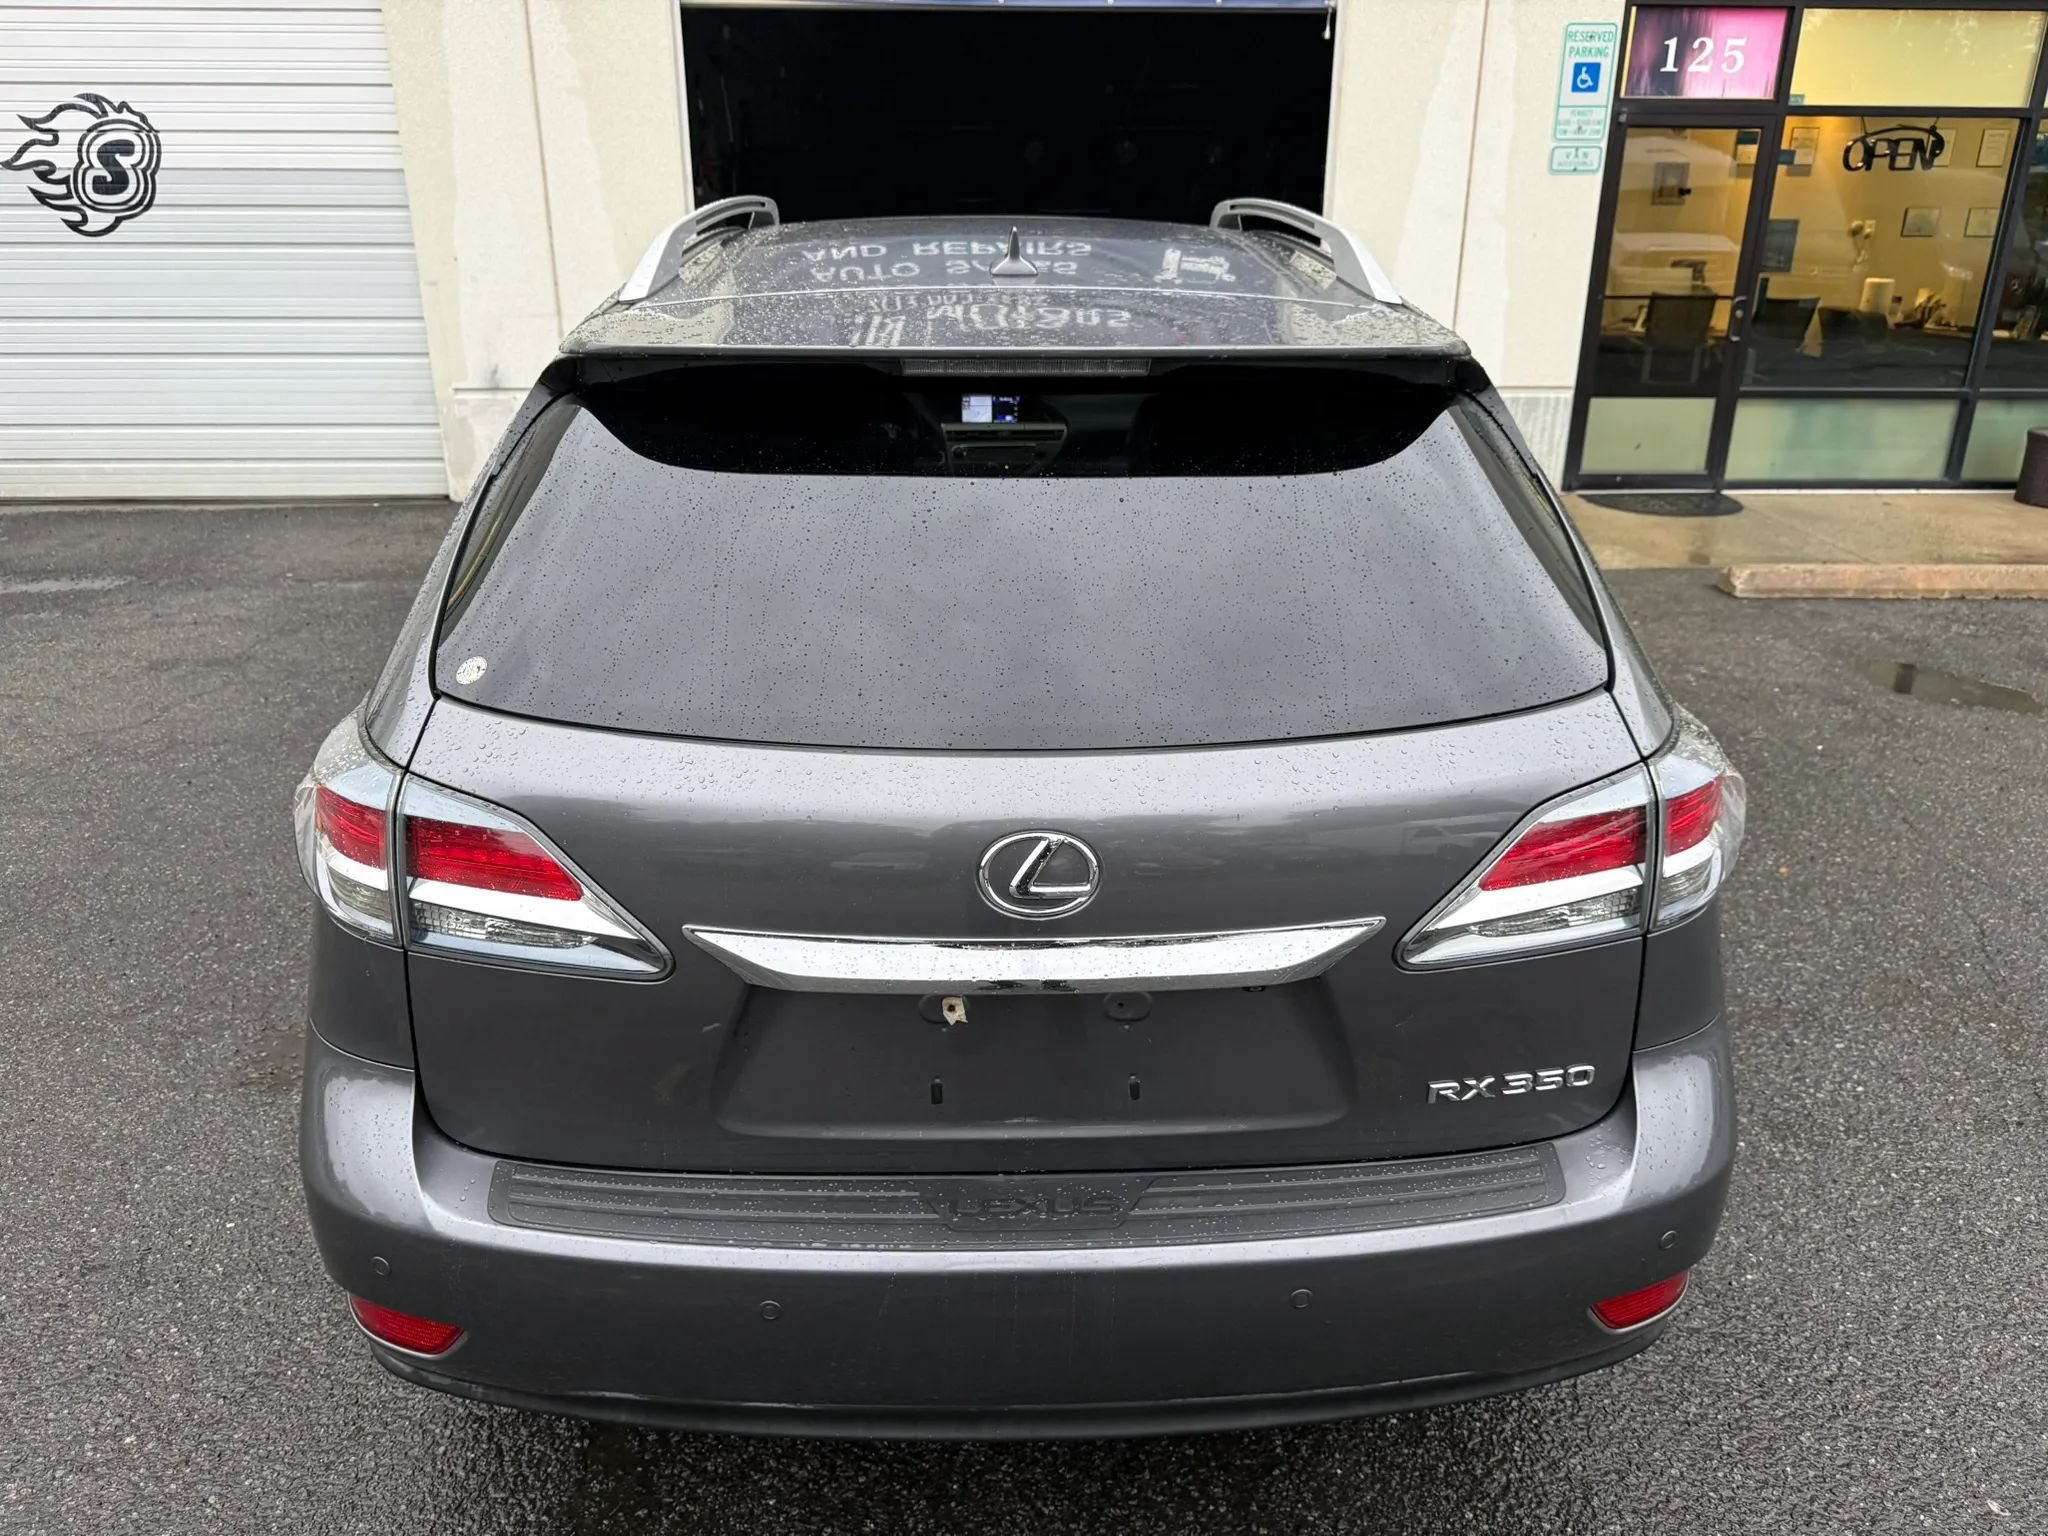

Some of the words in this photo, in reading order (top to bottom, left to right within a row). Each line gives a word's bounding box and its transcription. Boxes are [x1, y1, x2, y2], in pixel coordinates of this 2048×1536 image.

[1566, 31, 1615, 42] RESERVED
[1567, 46, 1609, 58] PARKING
[1659, 36, 1748, 73] 125
[1842, 135, 1939, 172] OPEN
[1427, 1075, 1496, 1104] RX
[1501, 1063, 1596, 1095] 350
[949, 1196, 1120, 1218] LEXUS
